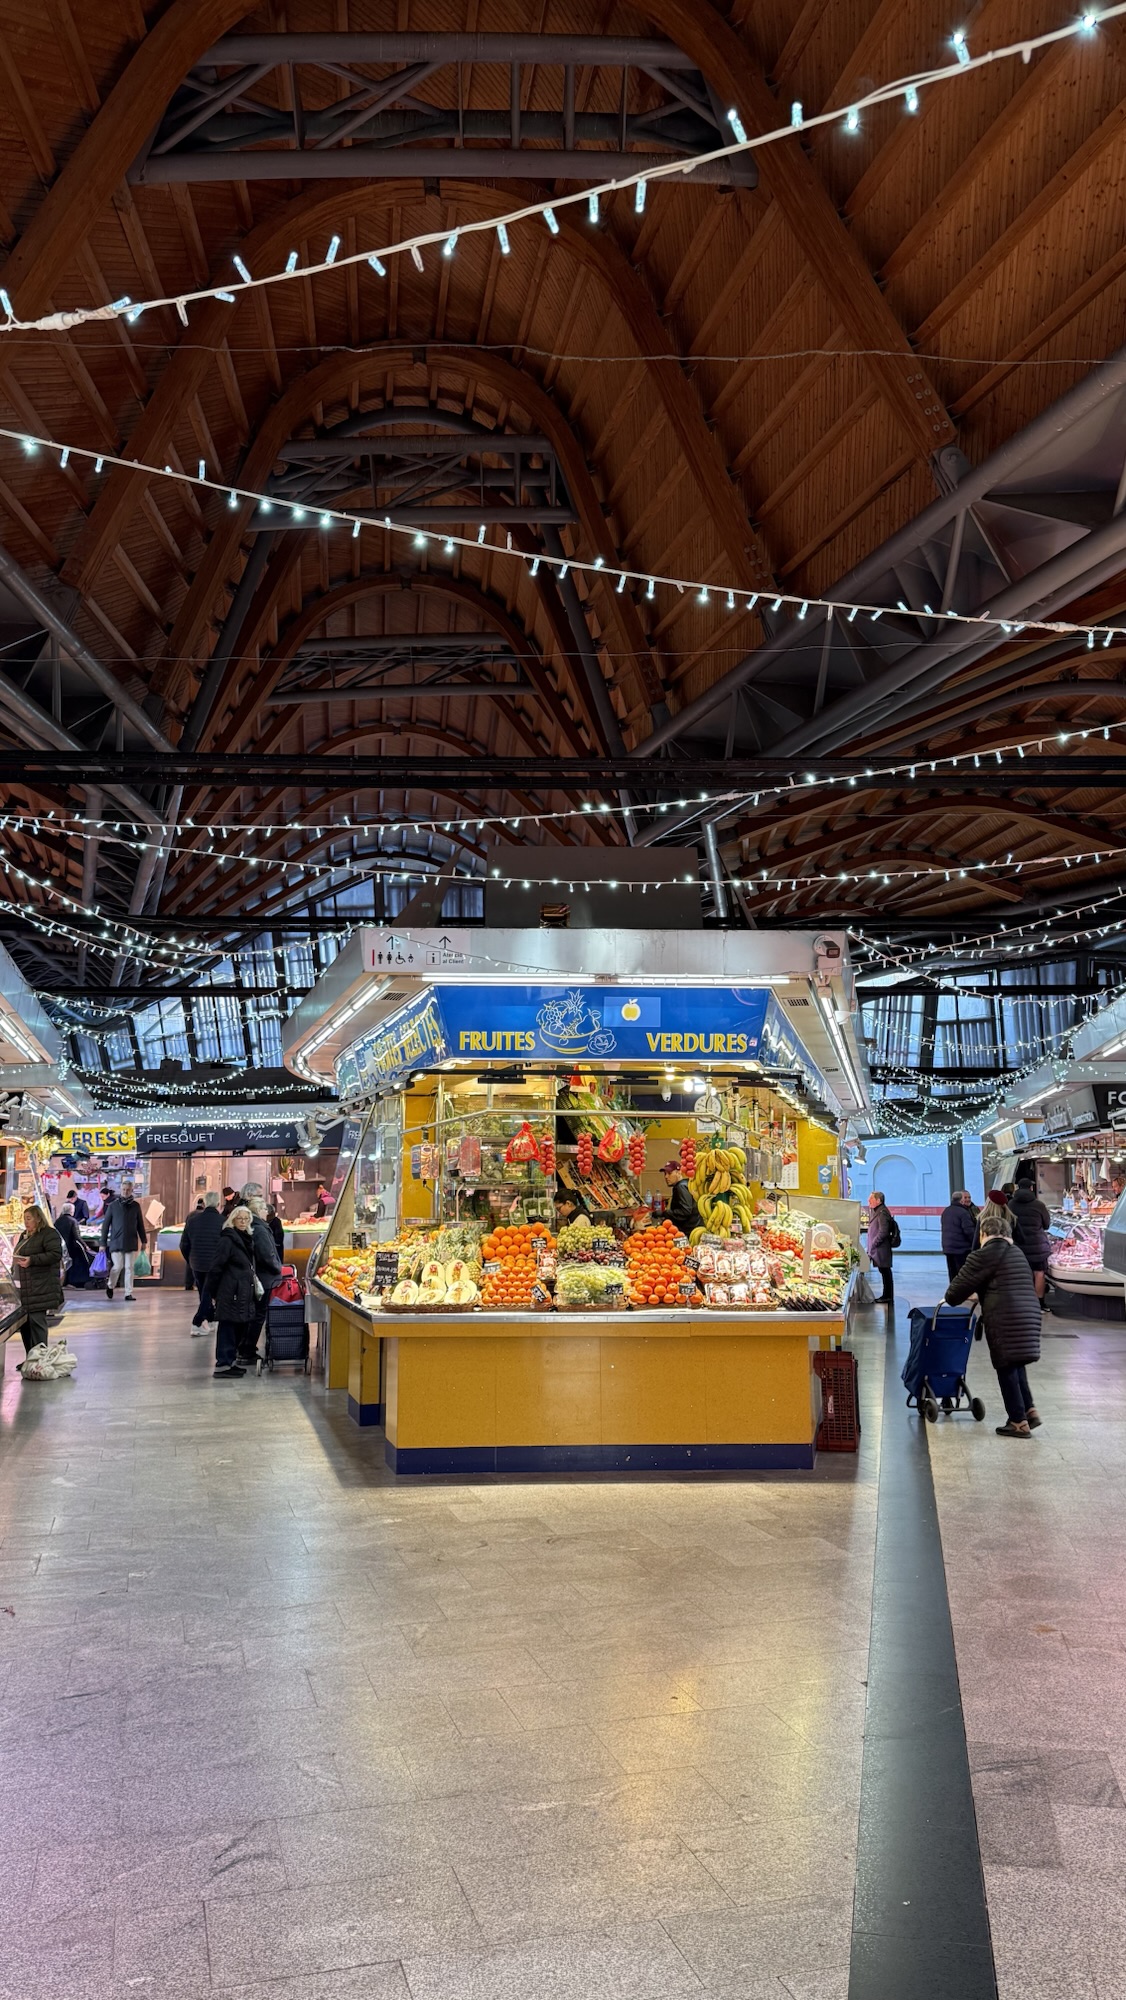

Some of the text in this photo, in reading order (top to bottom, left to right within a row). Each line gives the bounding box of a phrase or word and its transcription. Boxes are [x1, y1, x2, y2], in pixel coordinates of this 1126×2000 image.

[459, 1031, 536, 1051] FRUITES
[646, 1032, 748, 1053] VERDURES
[72, 1131, 129, 1148] FRESC
[146, 1133, 215, 1144] FRESQUET
[247, 1130, 280, 1140] Merche
